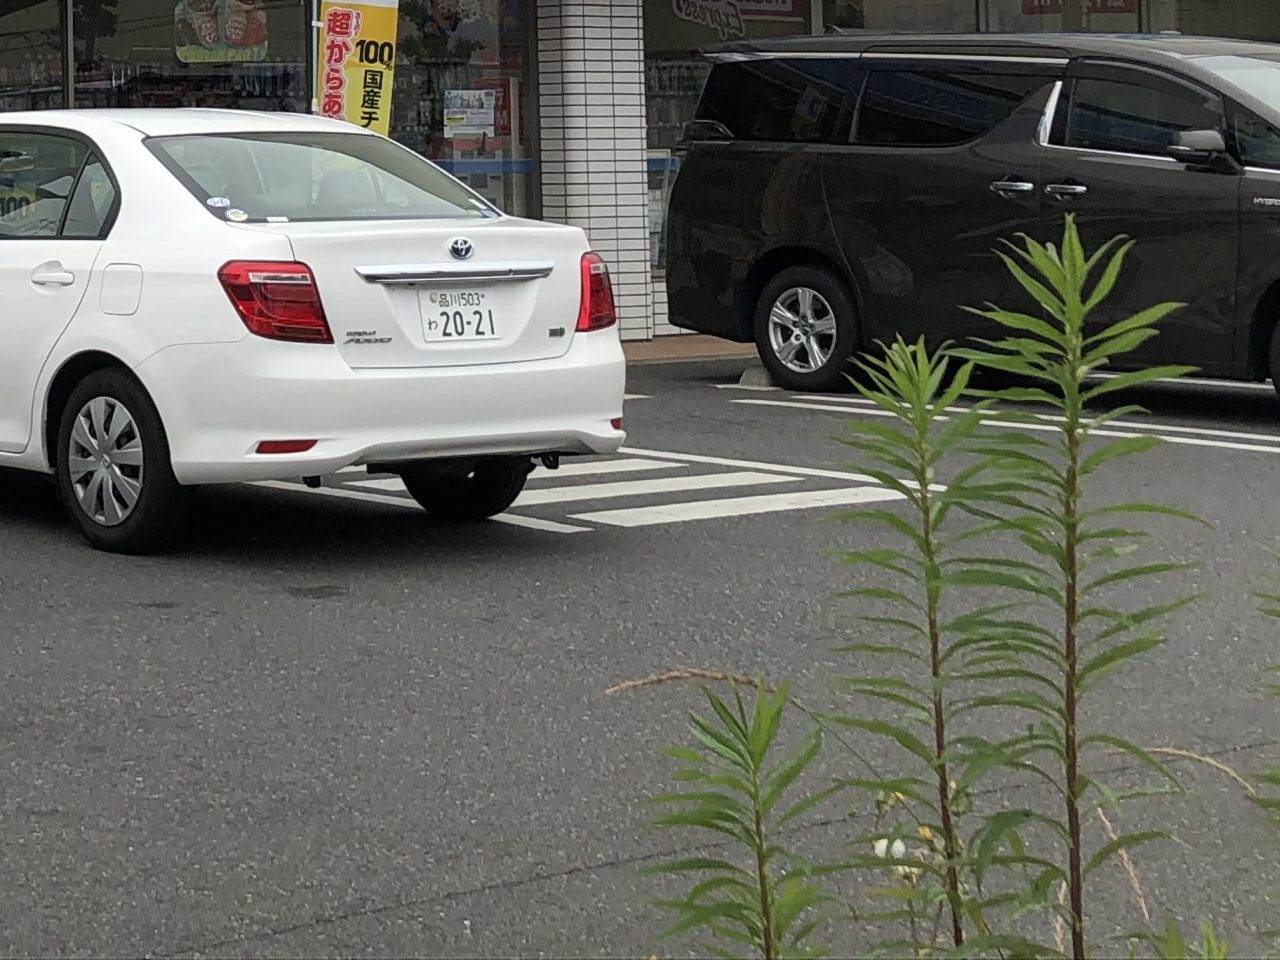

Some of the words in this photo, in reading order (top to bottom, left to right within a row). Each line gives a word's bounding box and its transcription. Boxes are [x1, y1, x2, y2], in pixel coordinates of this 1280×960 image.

[322, 11, 351, 120] 超からあ
[439, 293, 461, 307] 品川
[460, 292, 481, 307] 503
[427, 318, 439, 331] わ
[439, 309, 495, 337] 20-21
